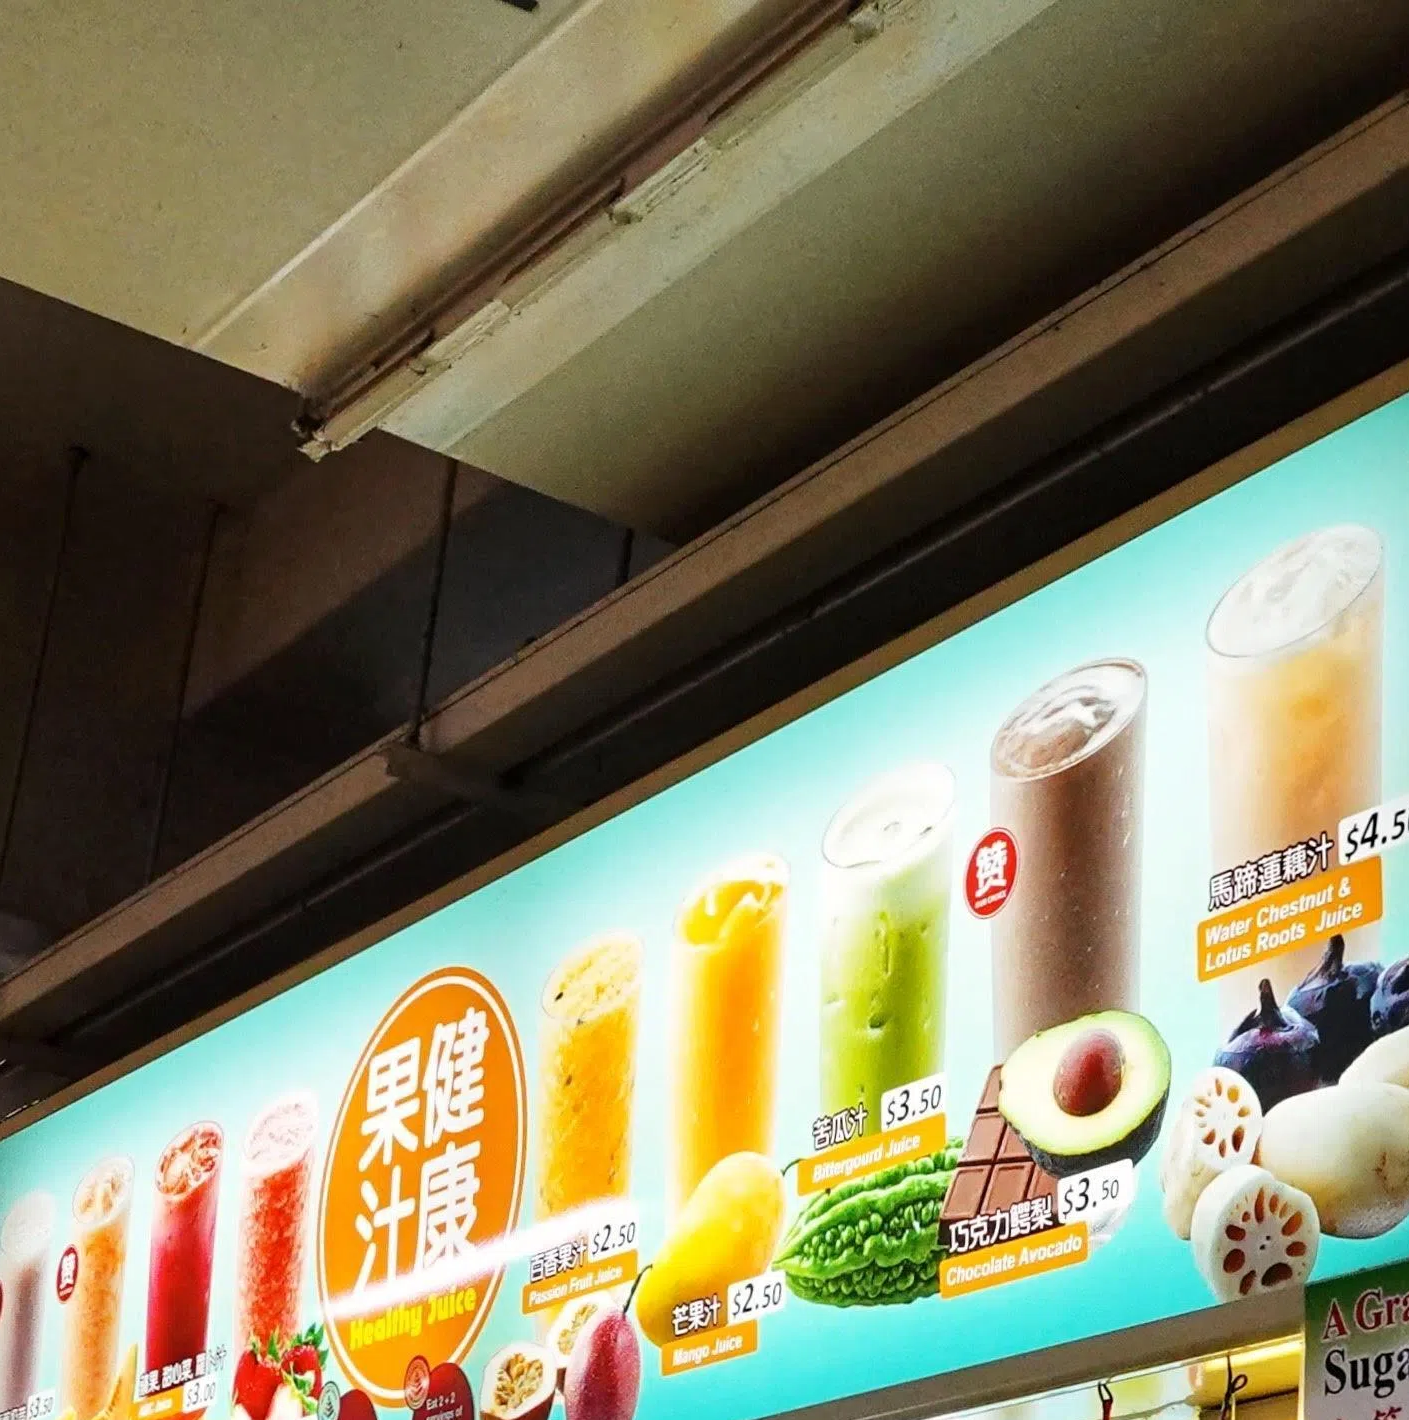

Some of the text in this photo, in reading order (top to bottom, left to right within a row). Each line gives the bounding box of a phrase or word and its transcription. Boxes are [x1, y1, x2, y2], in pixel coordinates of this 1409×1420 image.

[1204, 883, 1335, 948] Water Chestnut
[1204, 902, 1364, 973] Lotus Roots Juice
[812, 1103, 868, 1151] 苦瓜汁
[886, 1084, 942, 1128] $3.50
[886, 1132, 921, 1159] Juice
[530, 1236, 588, 1284] 百香果汁
[591, 1221, 636, 1256] $2.50
[946, 1233, 1083, 1287] Chocolate Avocado
[349, 1286, 477, 1351] Healthy Juice
[672, 1292, 722, 1337] 芒果汁
[732, 1282, 783, 1318] $2.50
[1323, 1299, 1349, 1340] A
[672, 1333, 744, 1367] Mango Juice
[186, 1381, 217, 1409] $3.00
